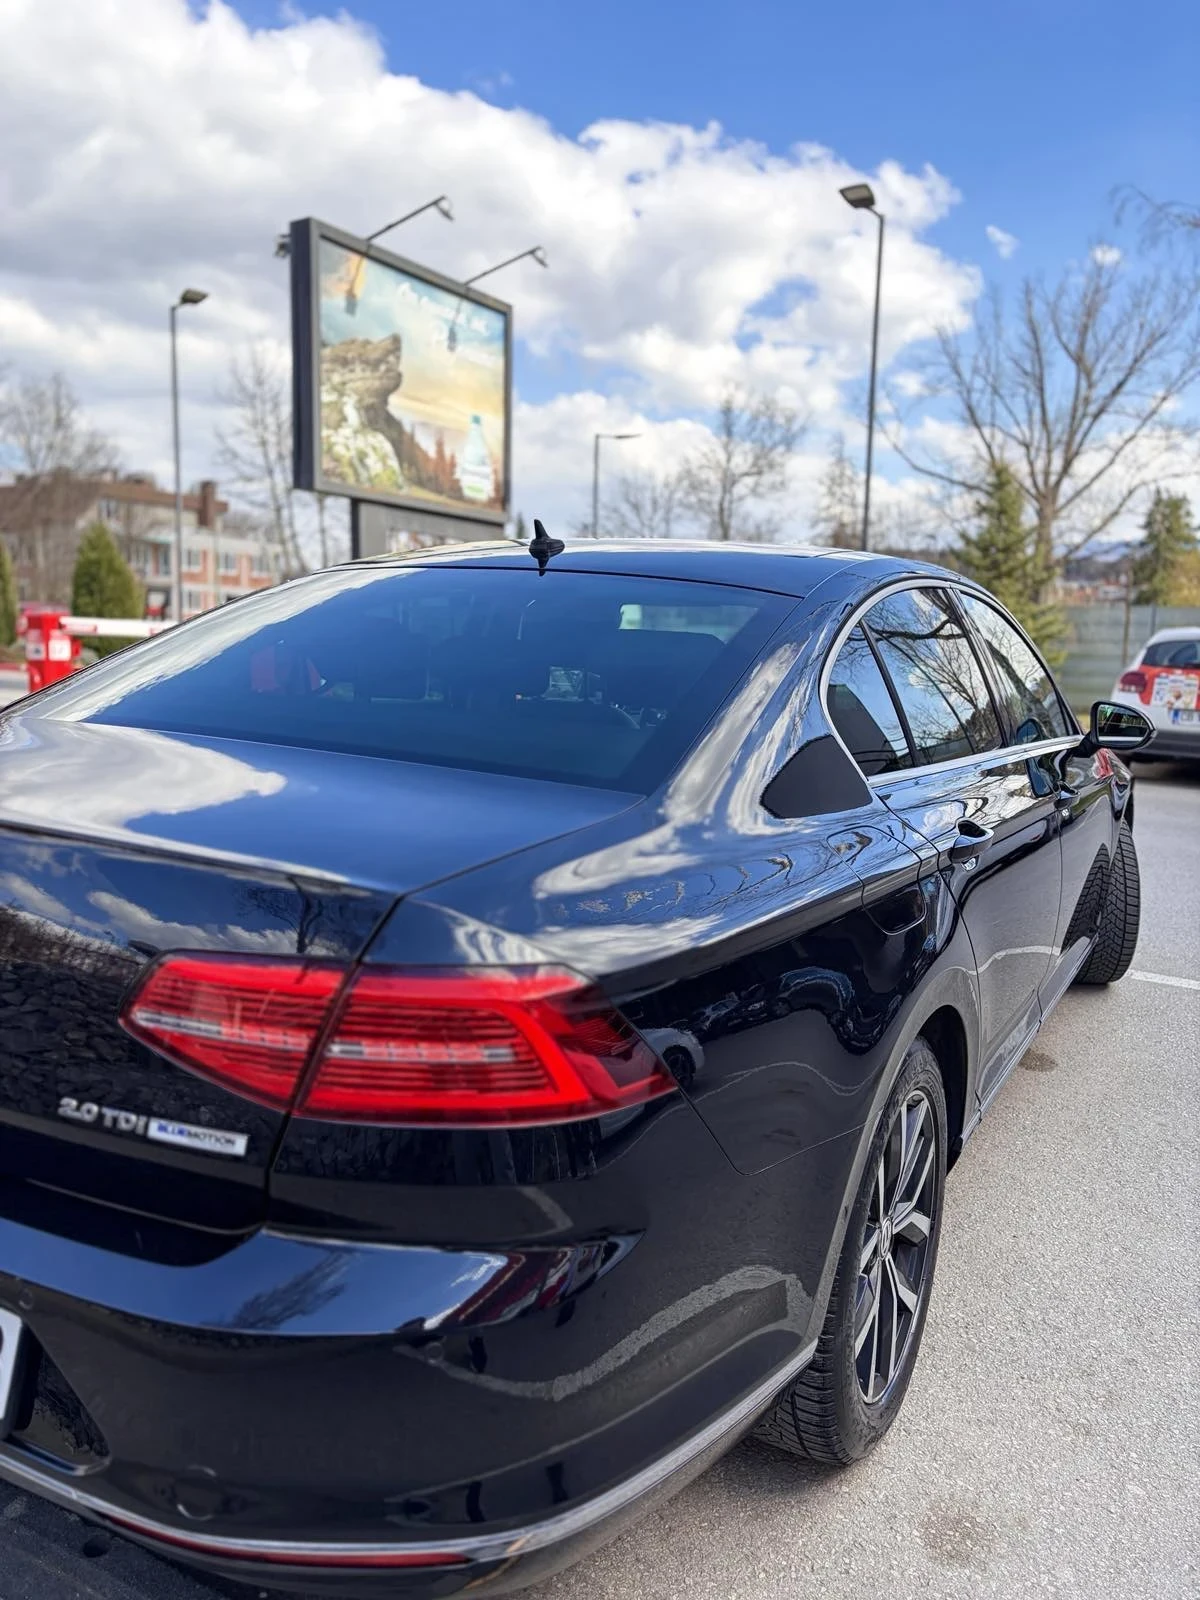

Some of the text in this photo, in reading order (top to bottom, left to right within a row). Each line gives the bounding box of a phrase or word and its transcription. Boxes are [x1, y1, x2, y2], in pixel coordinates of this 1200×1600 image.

[57, 1097, 236, 1146] 2.0 TDI BLUEMOTION
